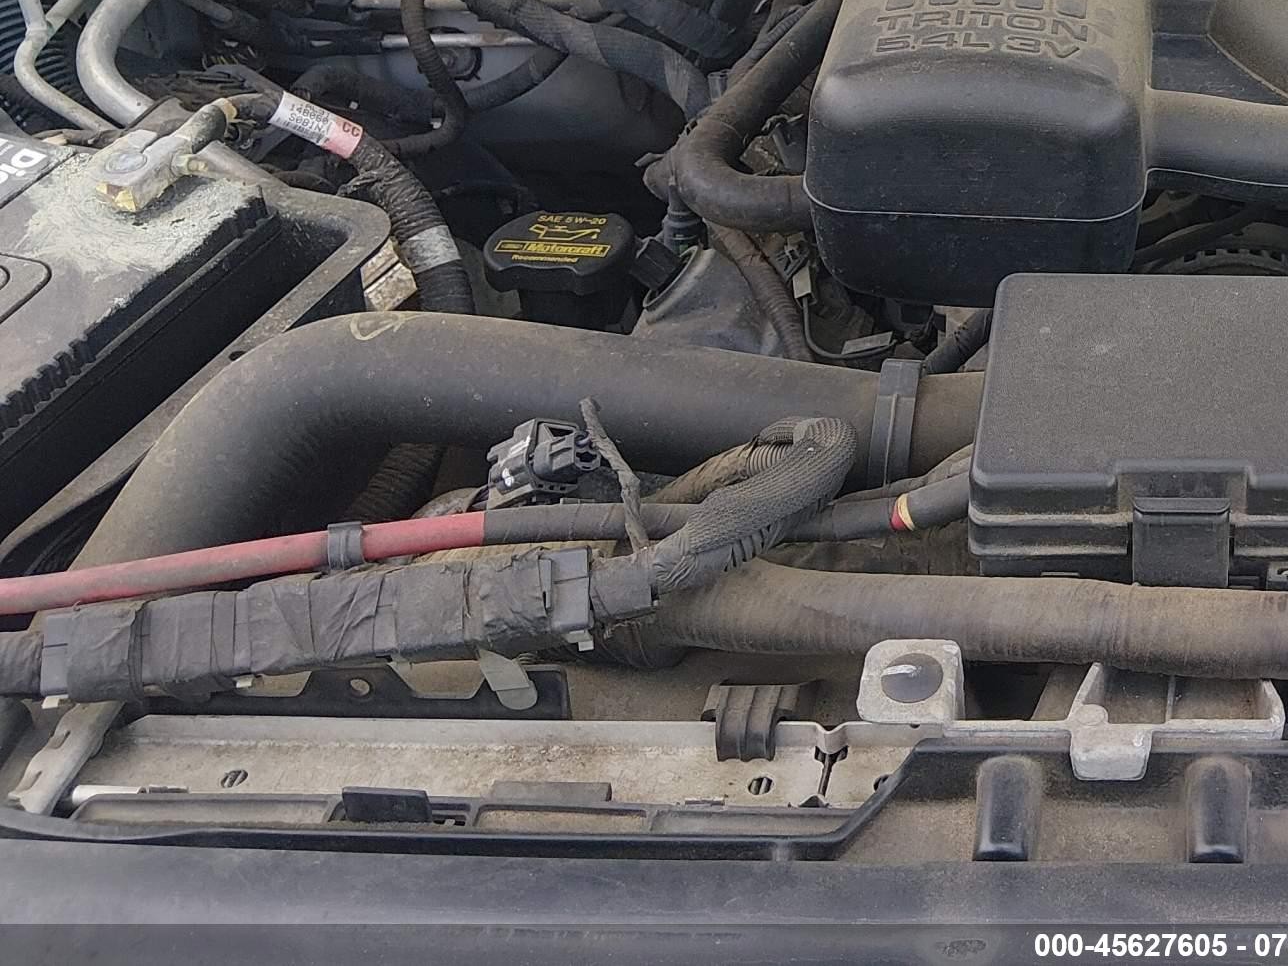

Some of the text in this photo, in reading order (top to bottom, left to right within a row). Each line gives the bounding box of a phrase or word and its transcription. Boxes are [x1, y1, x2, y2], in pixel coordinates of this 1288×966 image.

[877, 10, 1088, 42] TRITON
[876, 33, 1080, 58] 5.4L 3V
[537, 215, 607, 225] SAE 5W-20
[527, 242, 603, 255] Motorcraft
